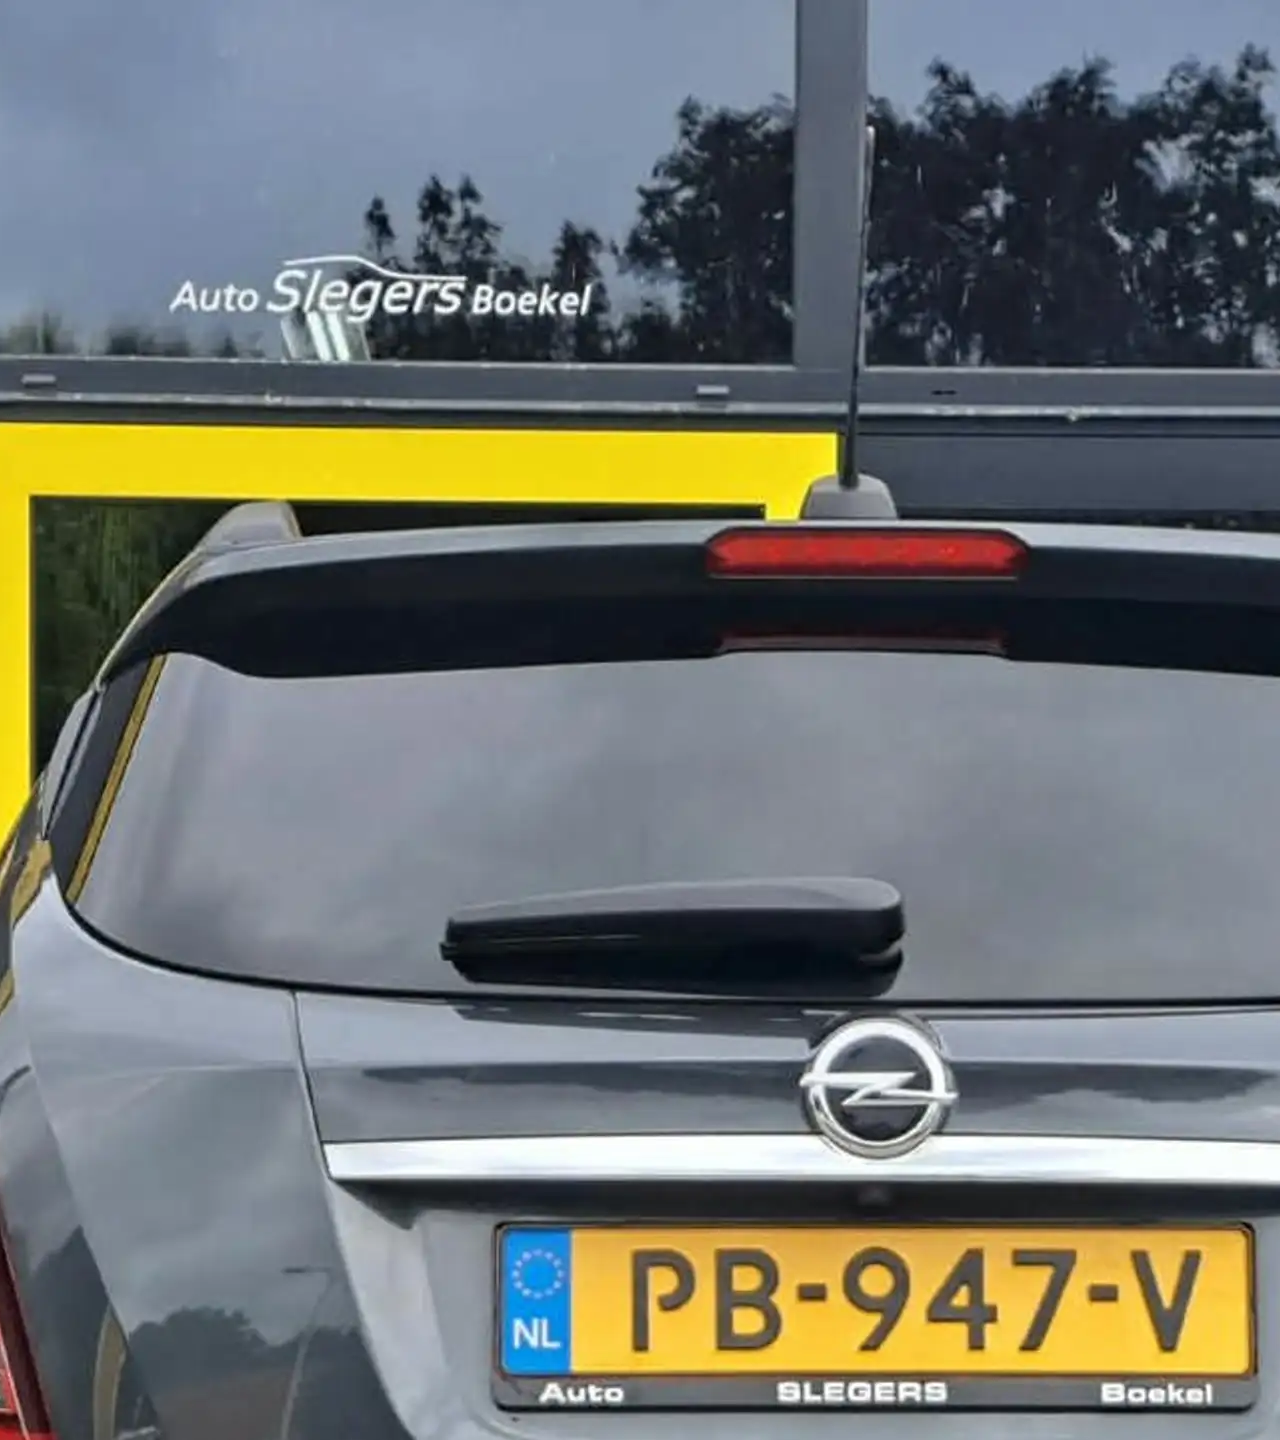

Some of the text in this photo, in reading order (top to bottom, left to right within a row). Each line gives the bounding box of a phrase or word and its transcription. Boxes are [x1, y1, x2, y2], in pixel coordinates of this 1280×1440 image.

[169, 267, 592, 322] Auto Slegers Boekel
[629, 1246, 1203, 1353] PB-947-V
[513, 1317, 561, 1349] NL
[538, 1381, 1213, 1404] Auto SLEGERS Boekel
